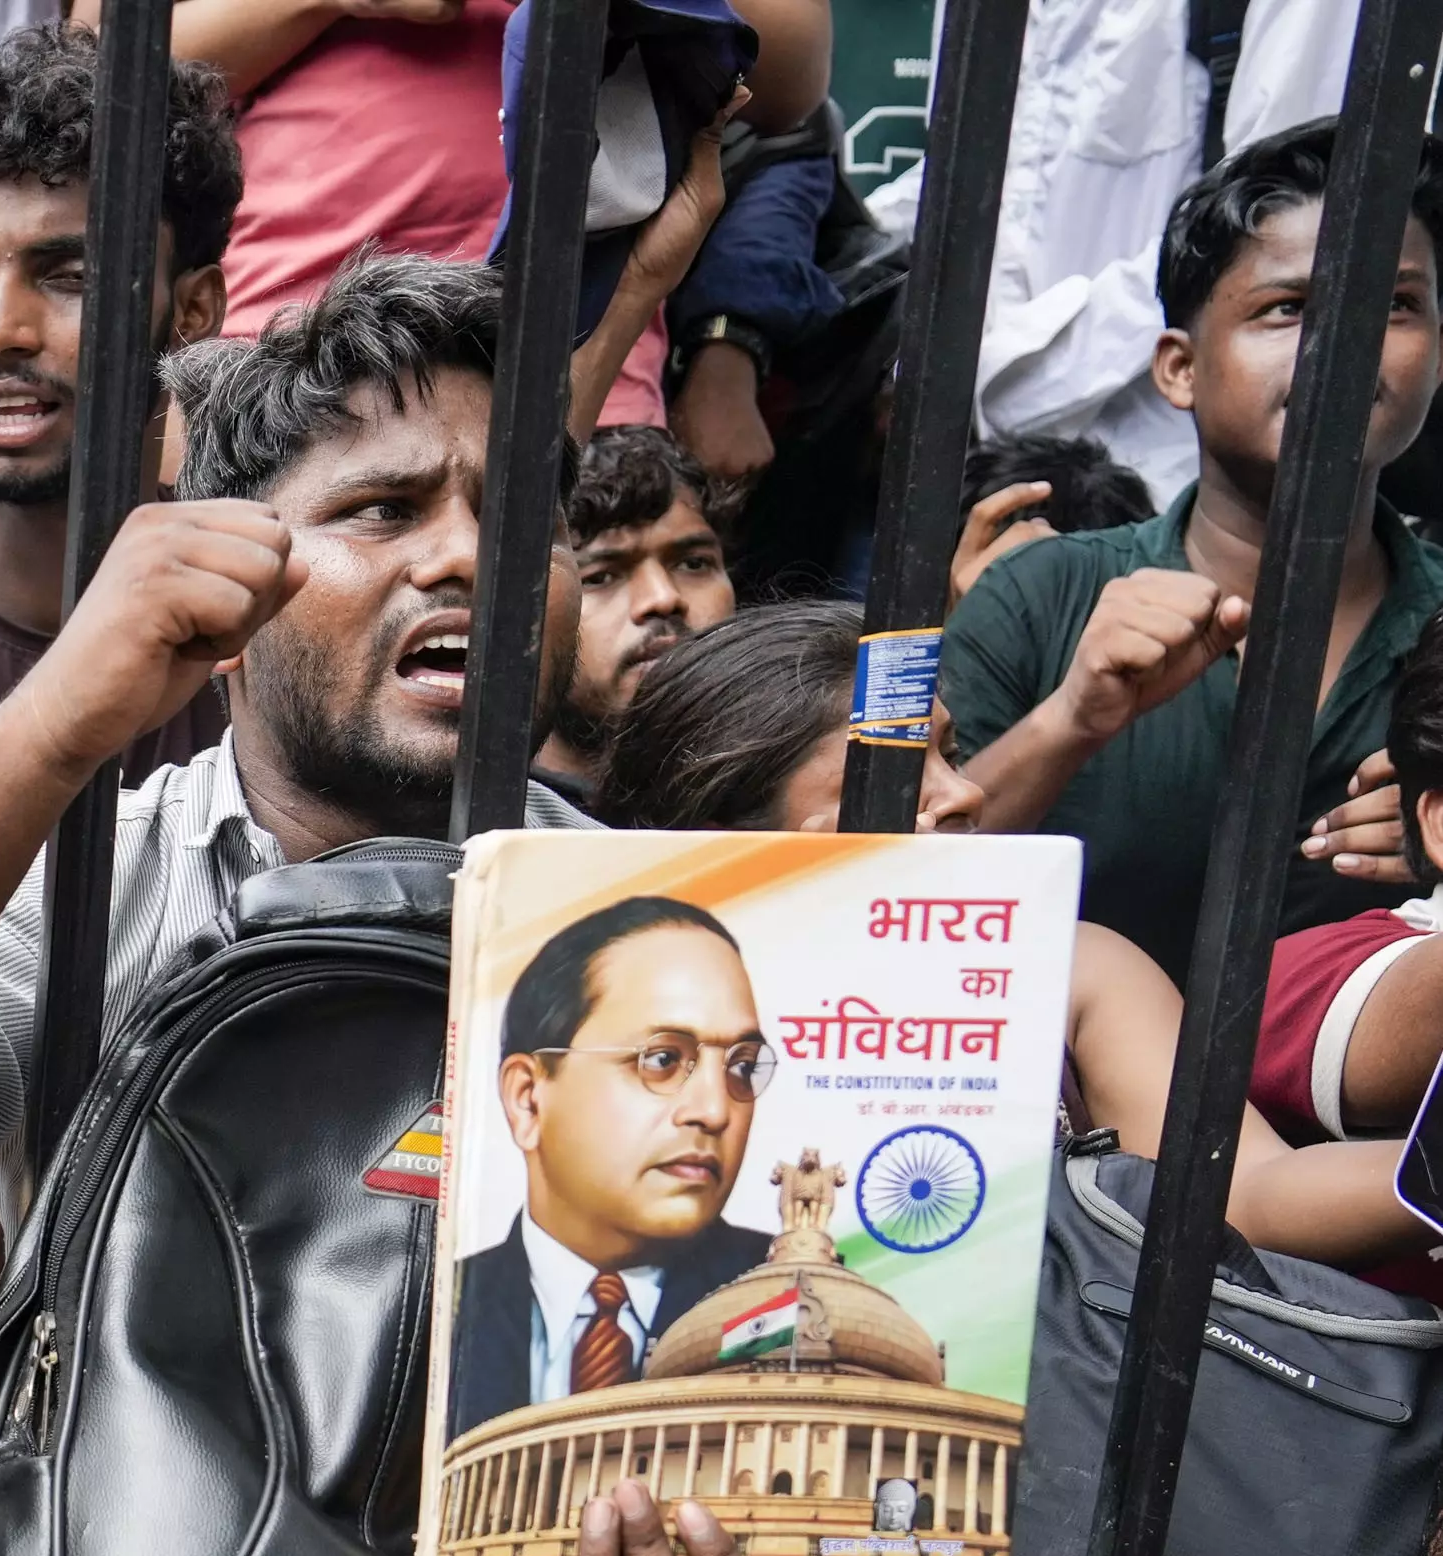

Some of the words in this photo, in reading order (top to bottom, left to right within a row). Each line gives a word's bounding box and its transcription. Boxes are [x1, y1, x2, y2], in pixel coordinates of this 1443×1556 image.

[869, 898, 1020, 943] भारत
[959, 968, 1013, 998] का
[778, 995, 1008, 1062] संविधान
[805, 1074, 830, 1090] THE
[835, 1074, 934, 1090] CONSTITUTION
[939, 1075, 956, 1090] OF
[961, 1075, 998, 1091] INDIA
[392, 1152, 441, 1173] TYCO
[1204, 1323, 1301, 1378] AMILIANT
